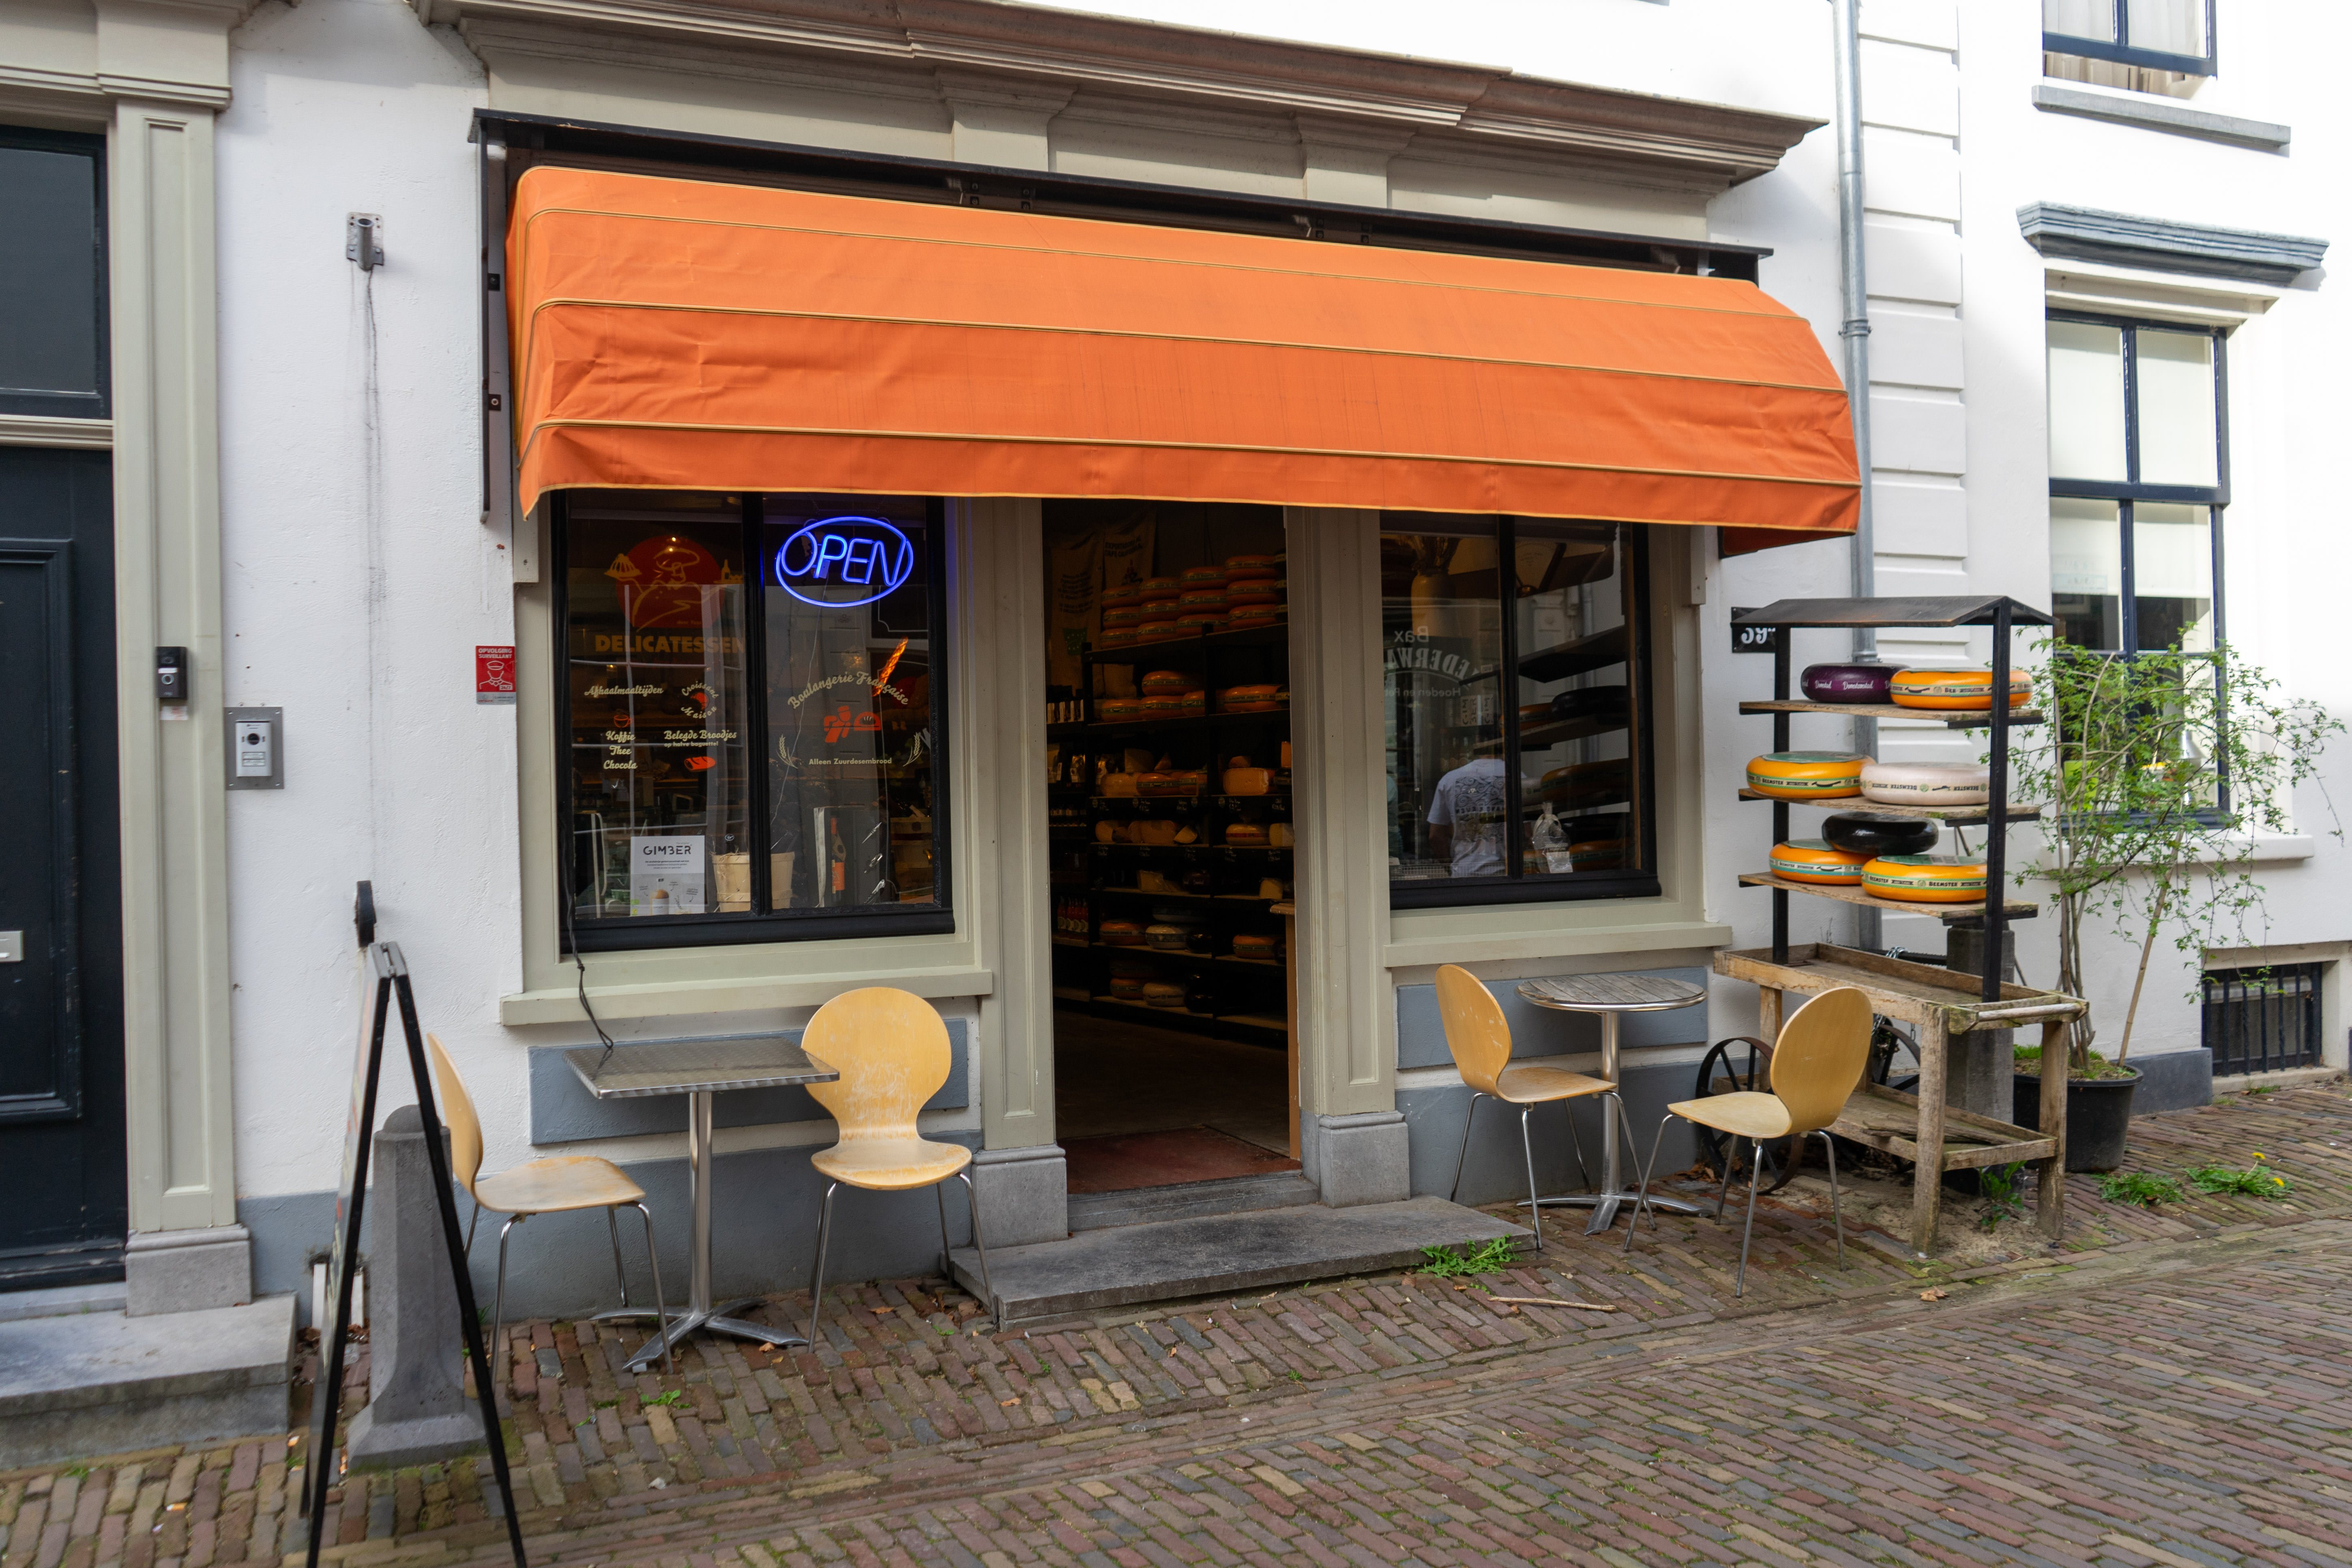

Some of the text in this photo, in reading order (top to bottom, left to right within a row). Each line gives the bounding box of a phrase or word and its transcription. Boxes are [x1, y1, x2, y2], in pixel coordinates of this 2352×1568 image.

[781, 531, 907, 587] OPEN
[595, 635, 745, 653] DELICATESSEN
[584, 684, 664, 697] Afhaalmaaltijden
[682, 681, 719, 699] Croissant
[788, 671, 909, 709] Boulangerie Française
[681, 706, 717, 719] Maison
[605, 730, 635, 743] Koffie
[664, 730, 737, 742] Belegde Broodjes
[609, 745, 632, 755] Thee
[603, 760, 638, 770] Chocola
[834, 757, 892, 765] Zuurdesembrood
[643, 845, 691, 855] GIMBER
